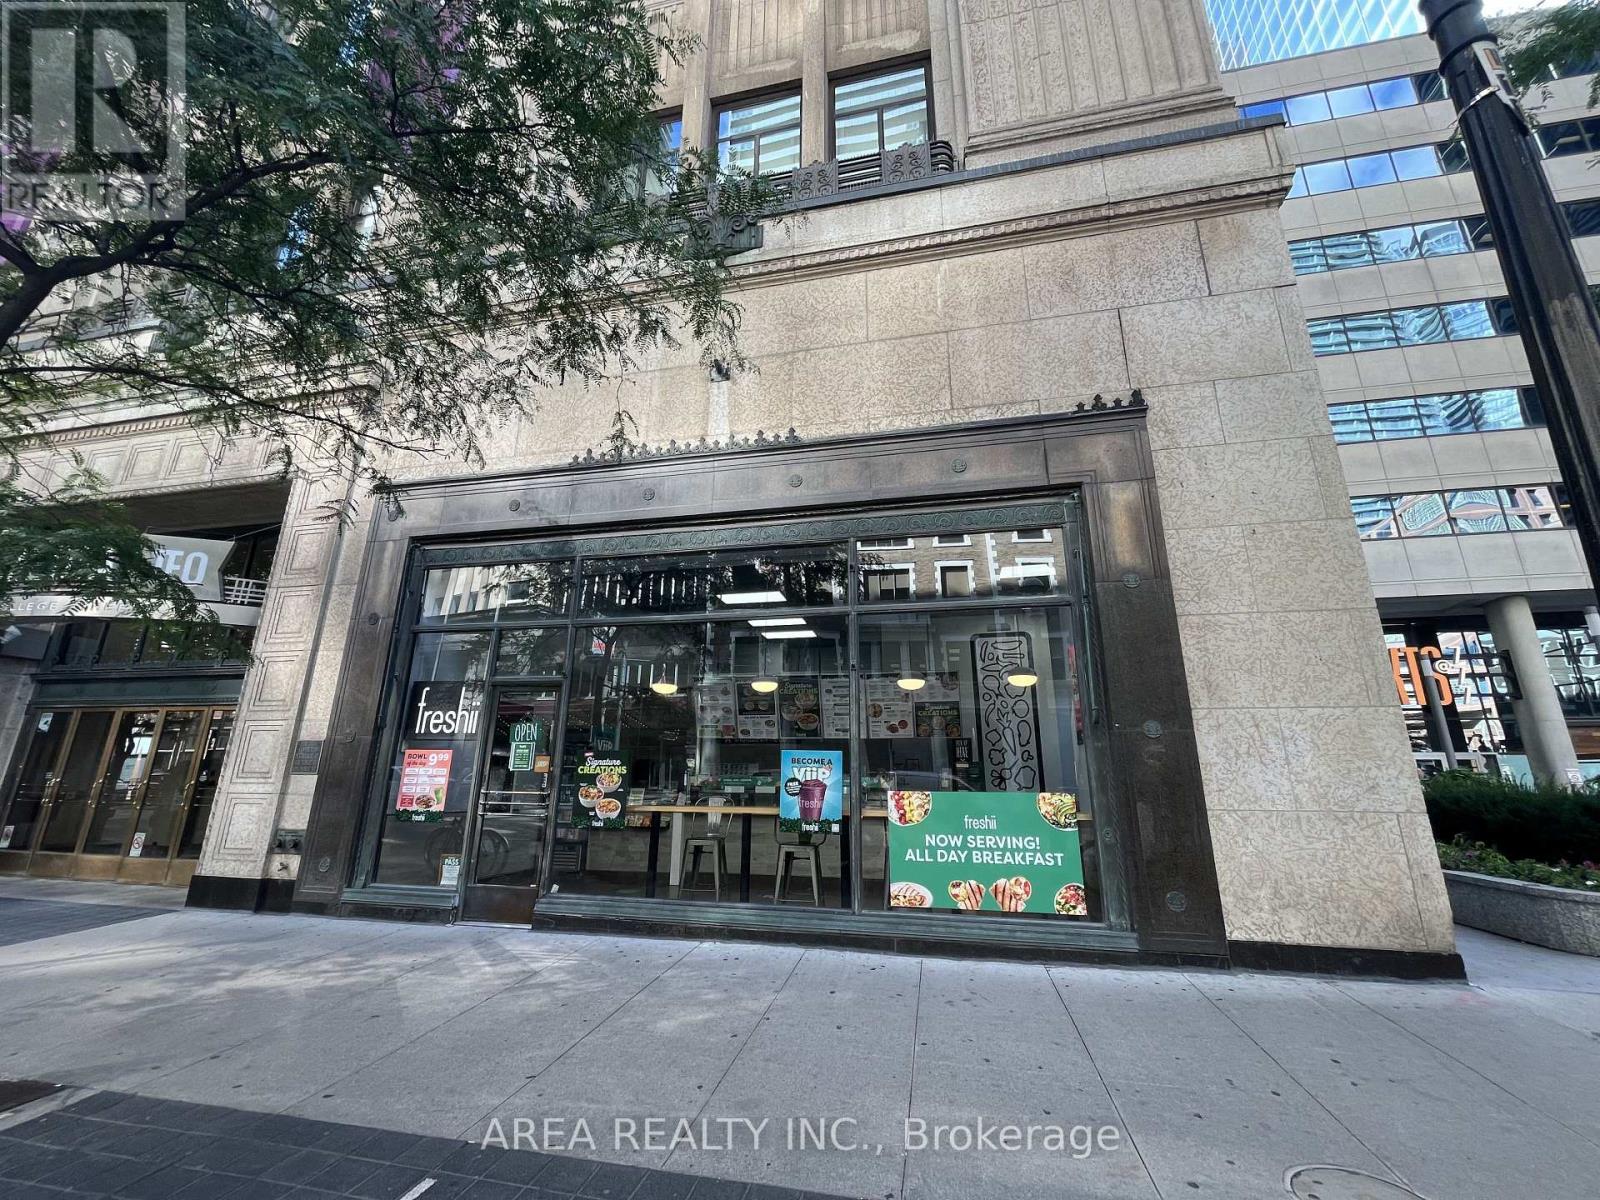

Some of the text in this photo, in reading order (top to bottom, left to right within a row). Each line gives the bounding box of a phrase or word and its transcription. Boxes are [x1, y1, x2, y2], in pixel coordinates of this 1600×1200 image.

[415, 686, 480, 734] freshii
[515, 723, 538, 742] OPEN
[585, 756, 622, 768] Signature
[791, 757, 833, 766] BECOME A
[578, 766, 627, 774] CREATIONS
[964, 814, 998, 830] freshii
[925, 834, 1041, 850] NOW SERVING!
[904, 849, 1065, 866] ALL DAY BREAKFAST
